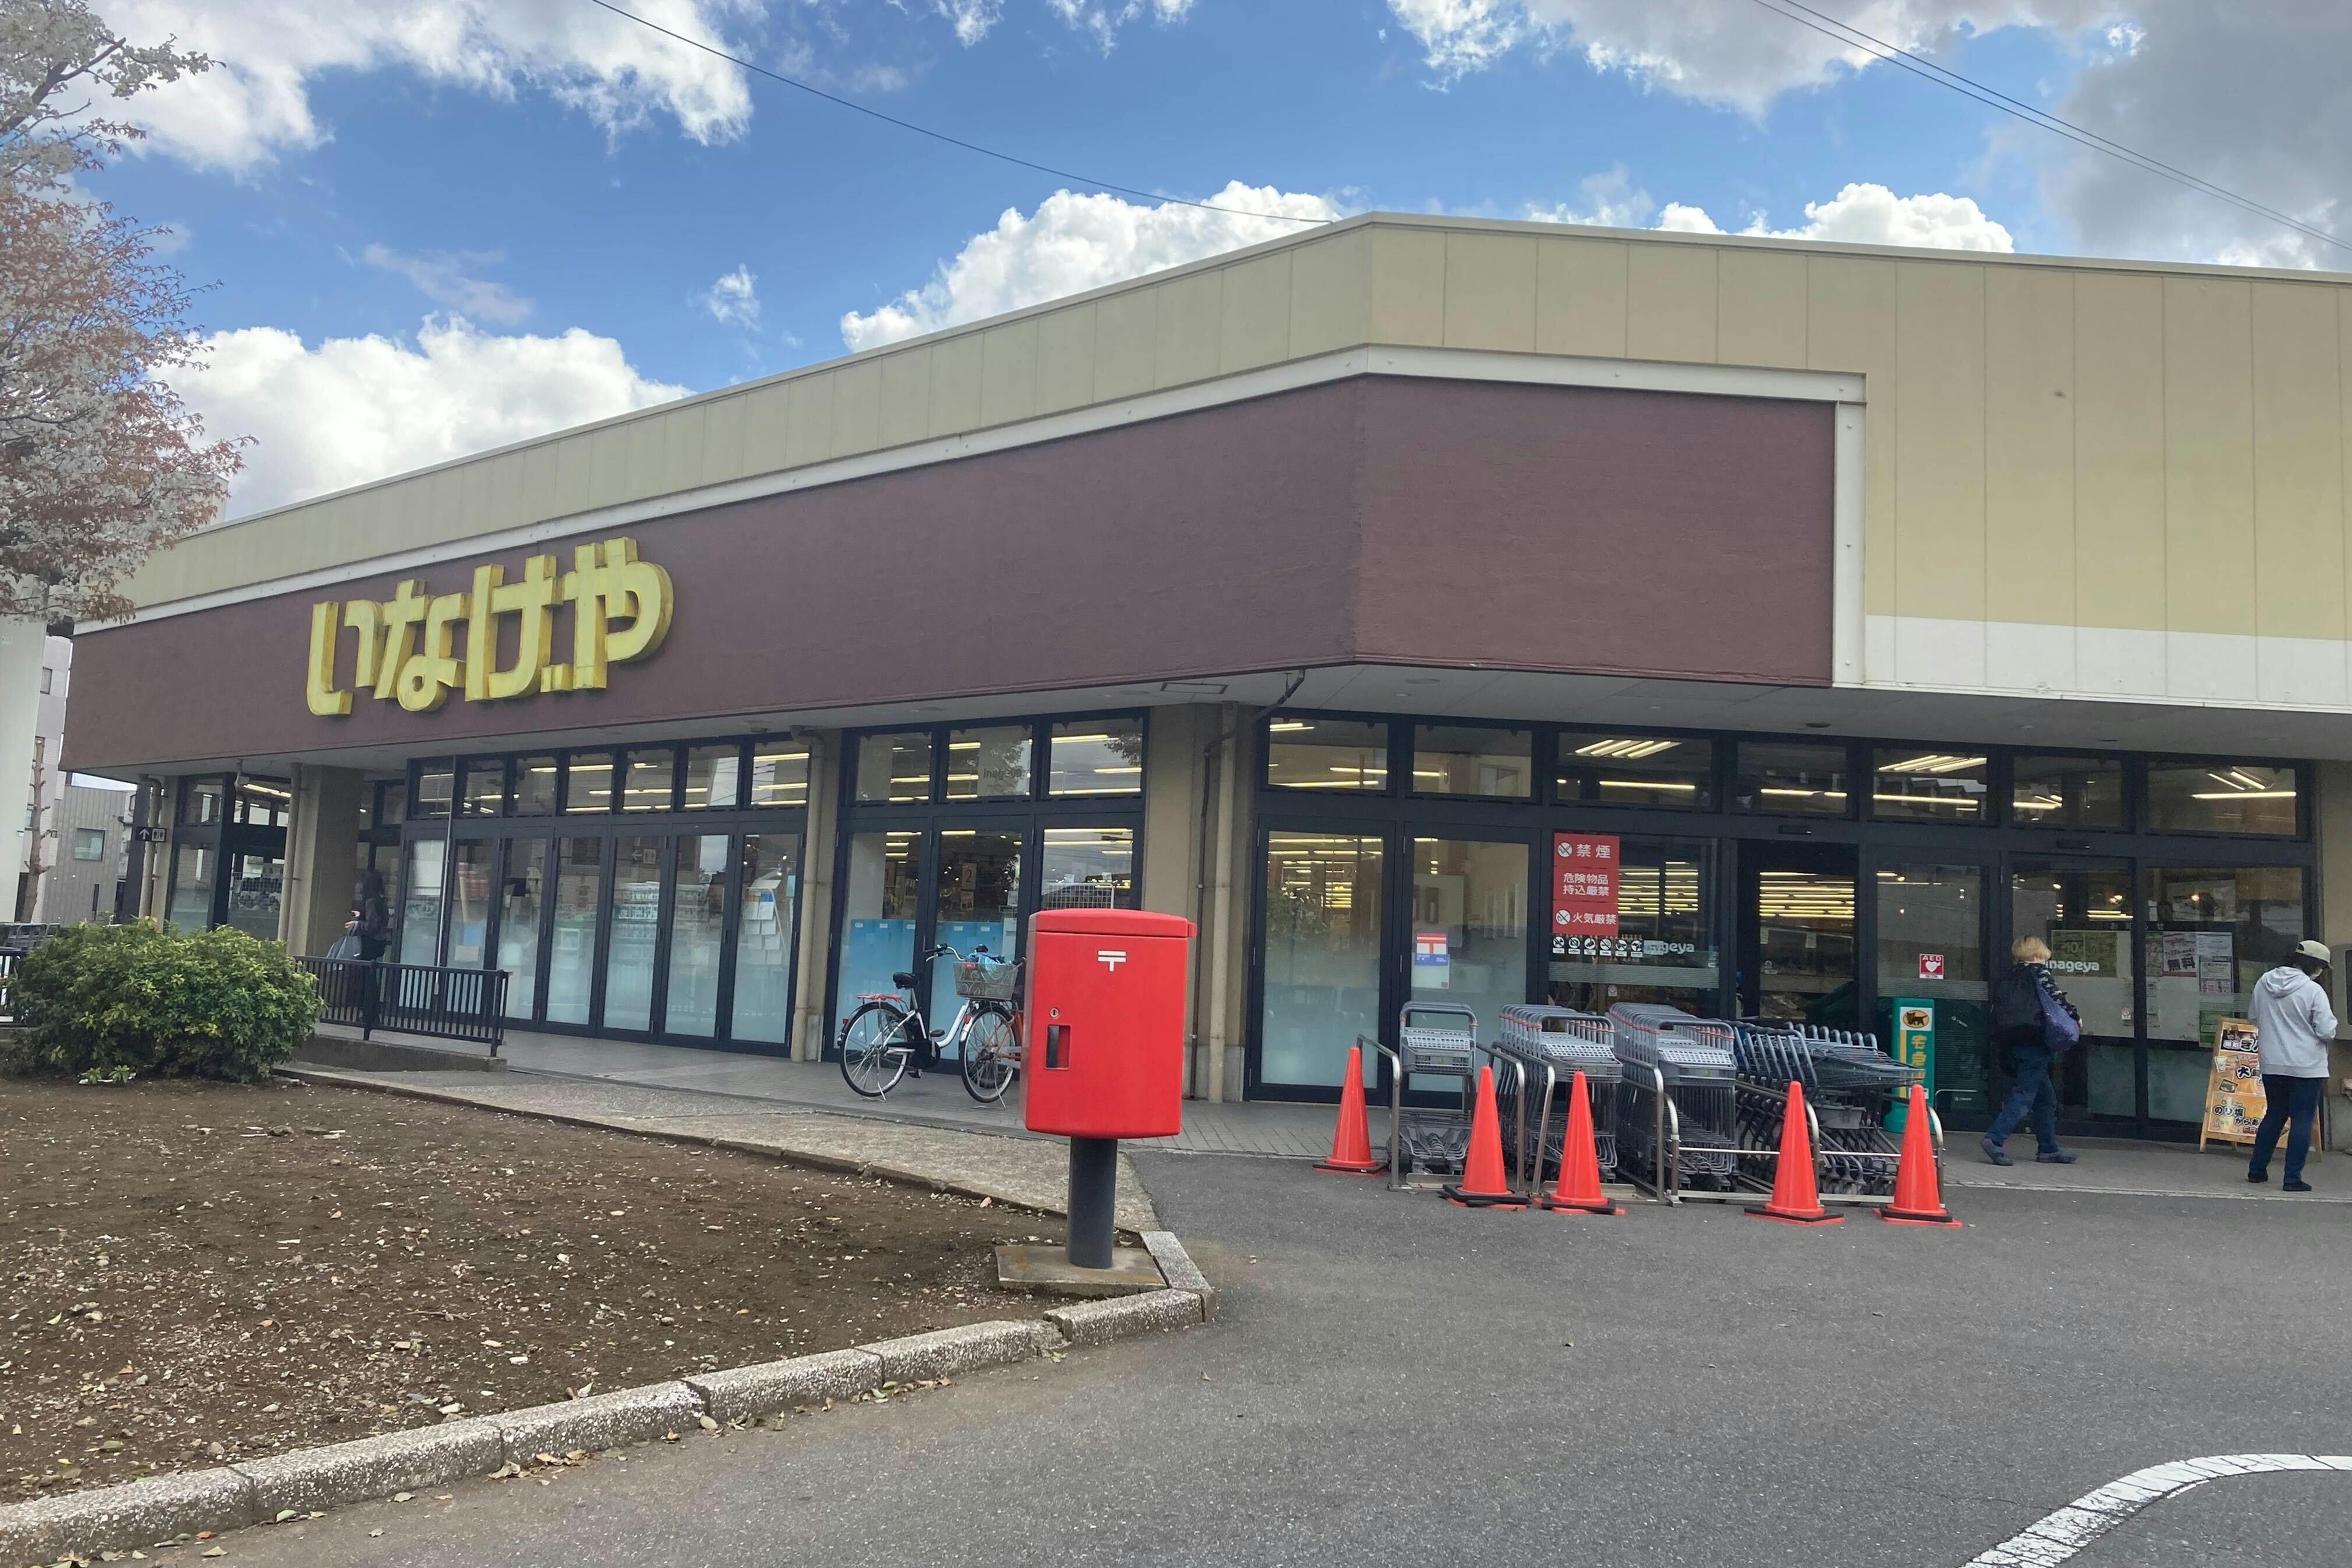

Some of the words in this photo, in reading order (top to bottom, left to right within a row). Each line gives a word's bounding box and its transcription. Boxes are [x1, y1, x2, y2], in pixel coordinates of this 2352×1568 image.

[307, 537, 673, 715] いなげや
[1576, 844, 1611, 859] 禁煙
[966, 869, 972, 883] 2
[1563, 872, 1608, 885] 危険物品
[1563, 884, 1609, 897] 持込厳禁
[1572, 912, 1616, 925] 火気厳禁
[1661, 942, 1695, 954] geya
